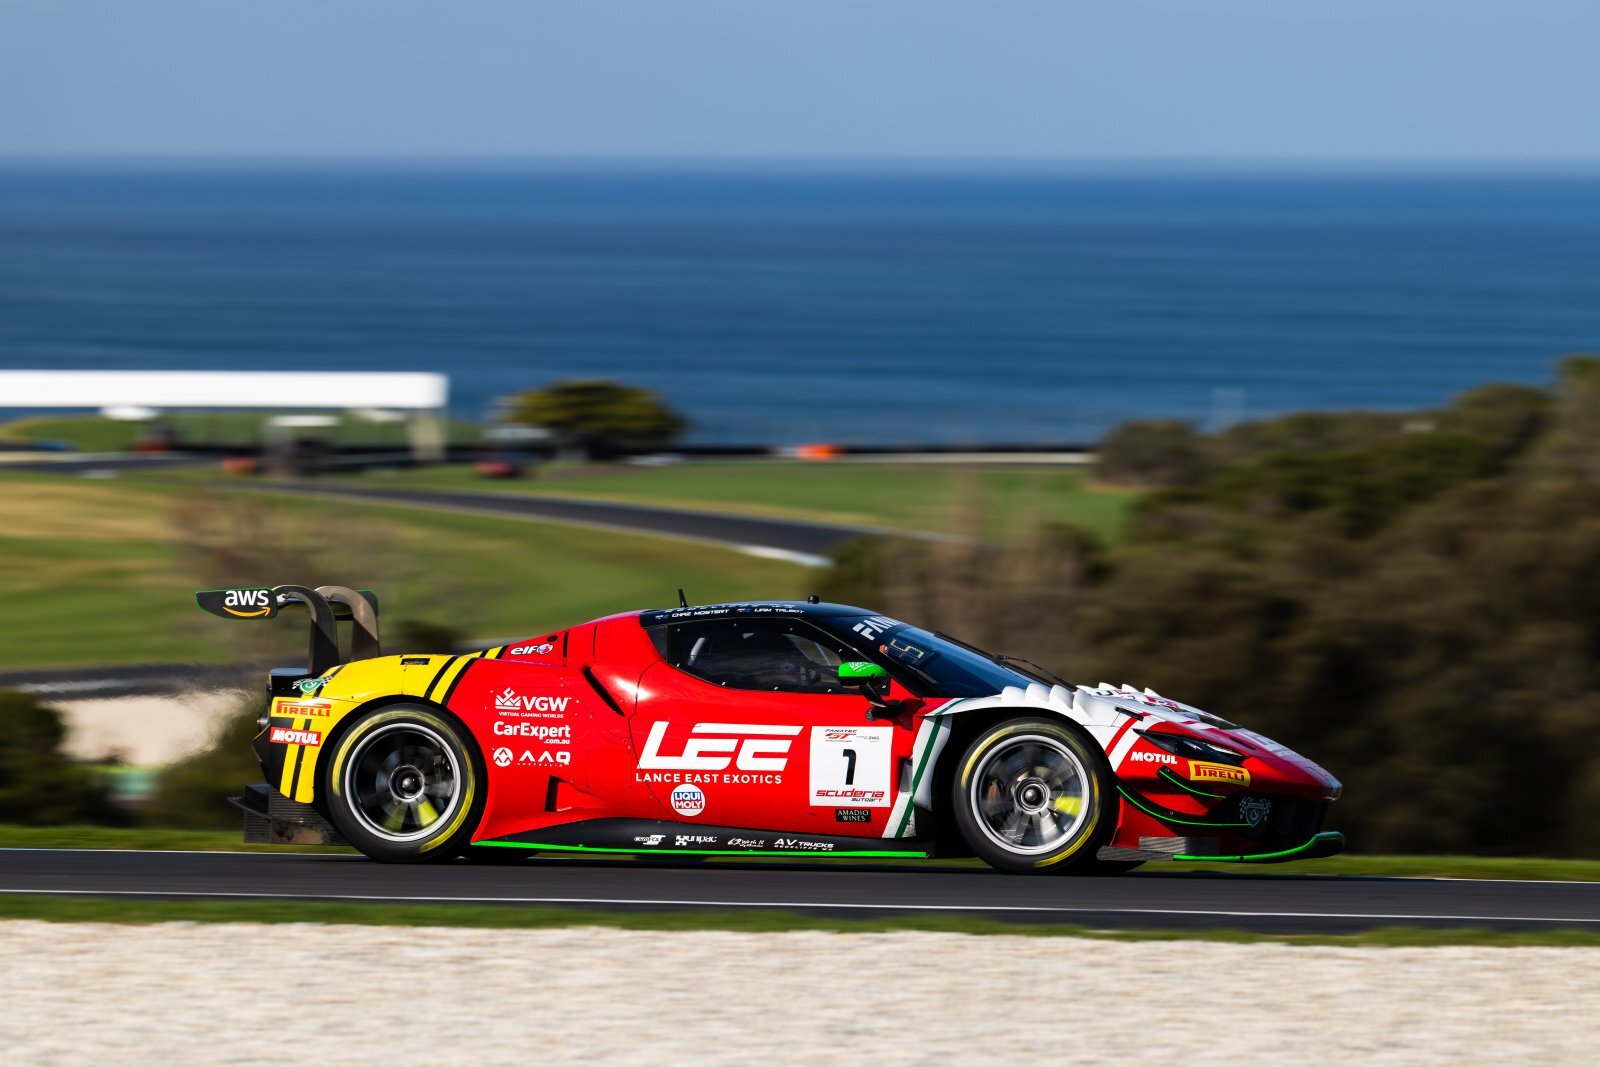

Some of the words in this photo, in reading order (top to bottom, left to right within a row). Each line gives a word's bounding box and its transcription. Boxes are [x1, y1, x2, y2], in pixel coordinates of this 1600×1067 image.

[225, 590, 269, 606] aws
[510, 645, 538, 655] elf
[276, 701, 332, 717] PIRELLI
[272, 729, 319, 745] MOTUL
[493, 721, 571, 740] CarExpert
[1130, 751, 1178, 764] MOTUL
[842, 749, 857, 785] 1
[1193, 764, 1245, 781] PIRELLI
[635, 773, 681, 783] LANCE
[685, 773, 719, 783] EAST
[723, 774, 782, 784] EXOTICS
[674, 792, 701, 801] LIQUI
[816, 788, 885, 798] scuderia
[675, 801, 702, 809] MOLY
